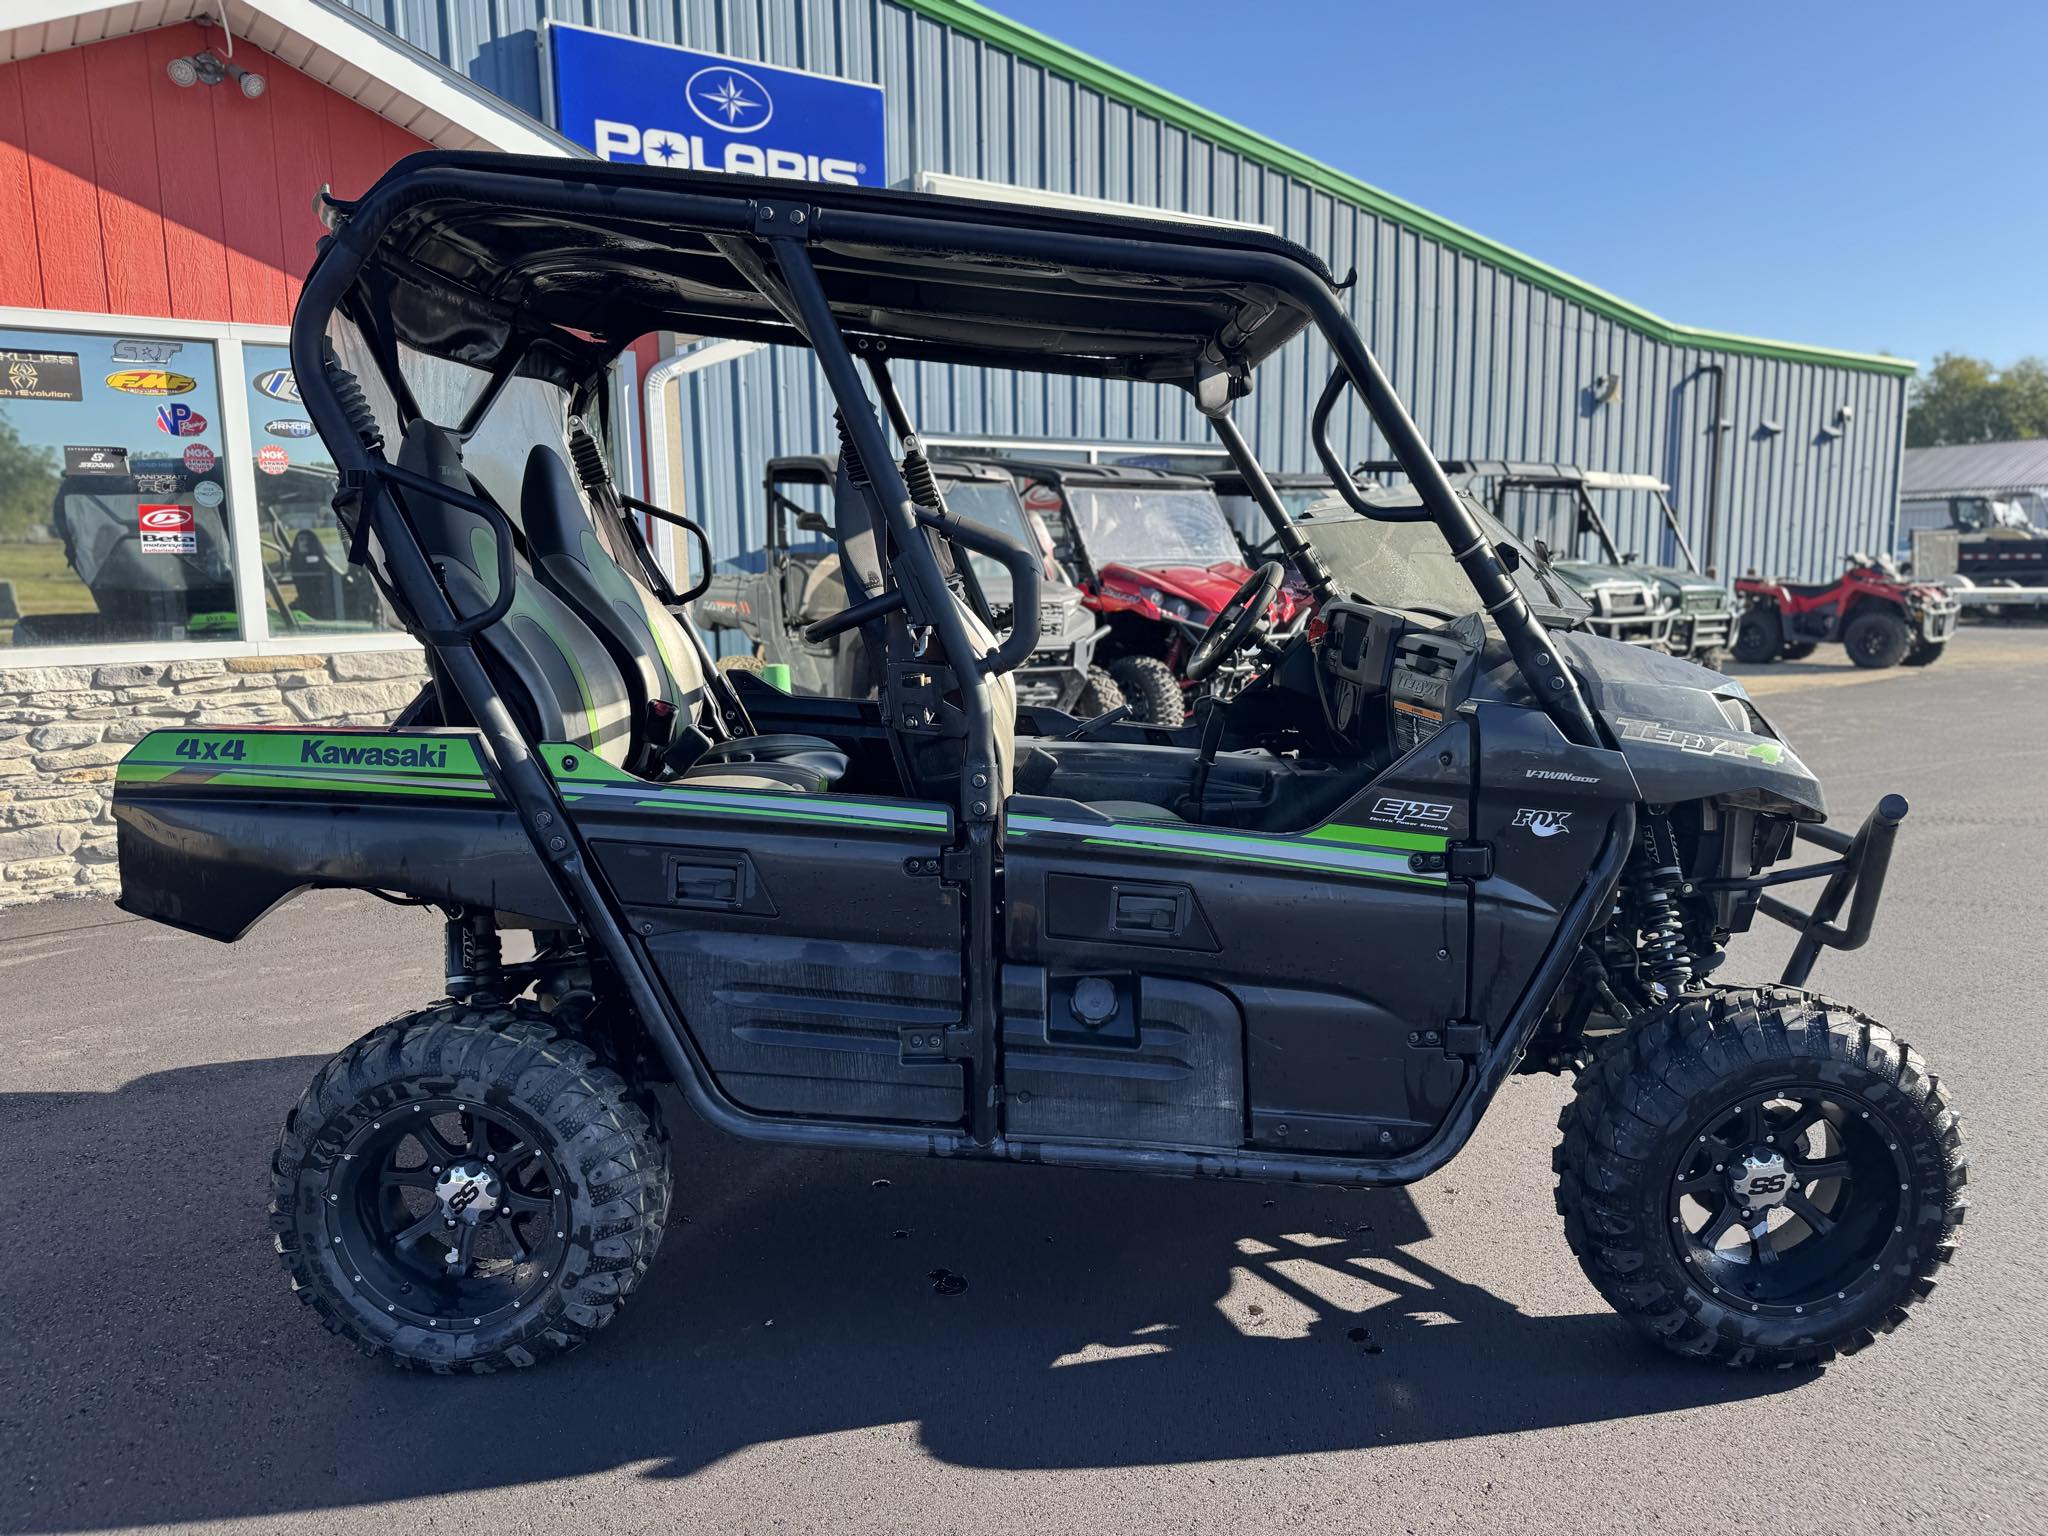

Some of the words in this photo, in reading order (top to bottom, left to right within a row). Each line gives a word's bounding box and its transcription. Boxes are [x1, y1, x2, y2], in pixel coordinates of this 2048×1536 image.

[109, 373, 193, 388] FMF
[15, 389, 71, 398] rEvolution
[157, 403, 191, 436] VP
[186, 448, 210, 458] NGK
[261, 450, 285, 459] NGK
[142, 534, 195, 542] Beta
[175, 738, 247, 761] 4x4
[300, 739, 447, 768] Kawasaki
[1419, 823, 1449, 831] Steering
[1511, 808, 1572, 831] FOX
[1748, 1173, 1787, 1195] SS
[449, 1180, 479, 1215] SS
